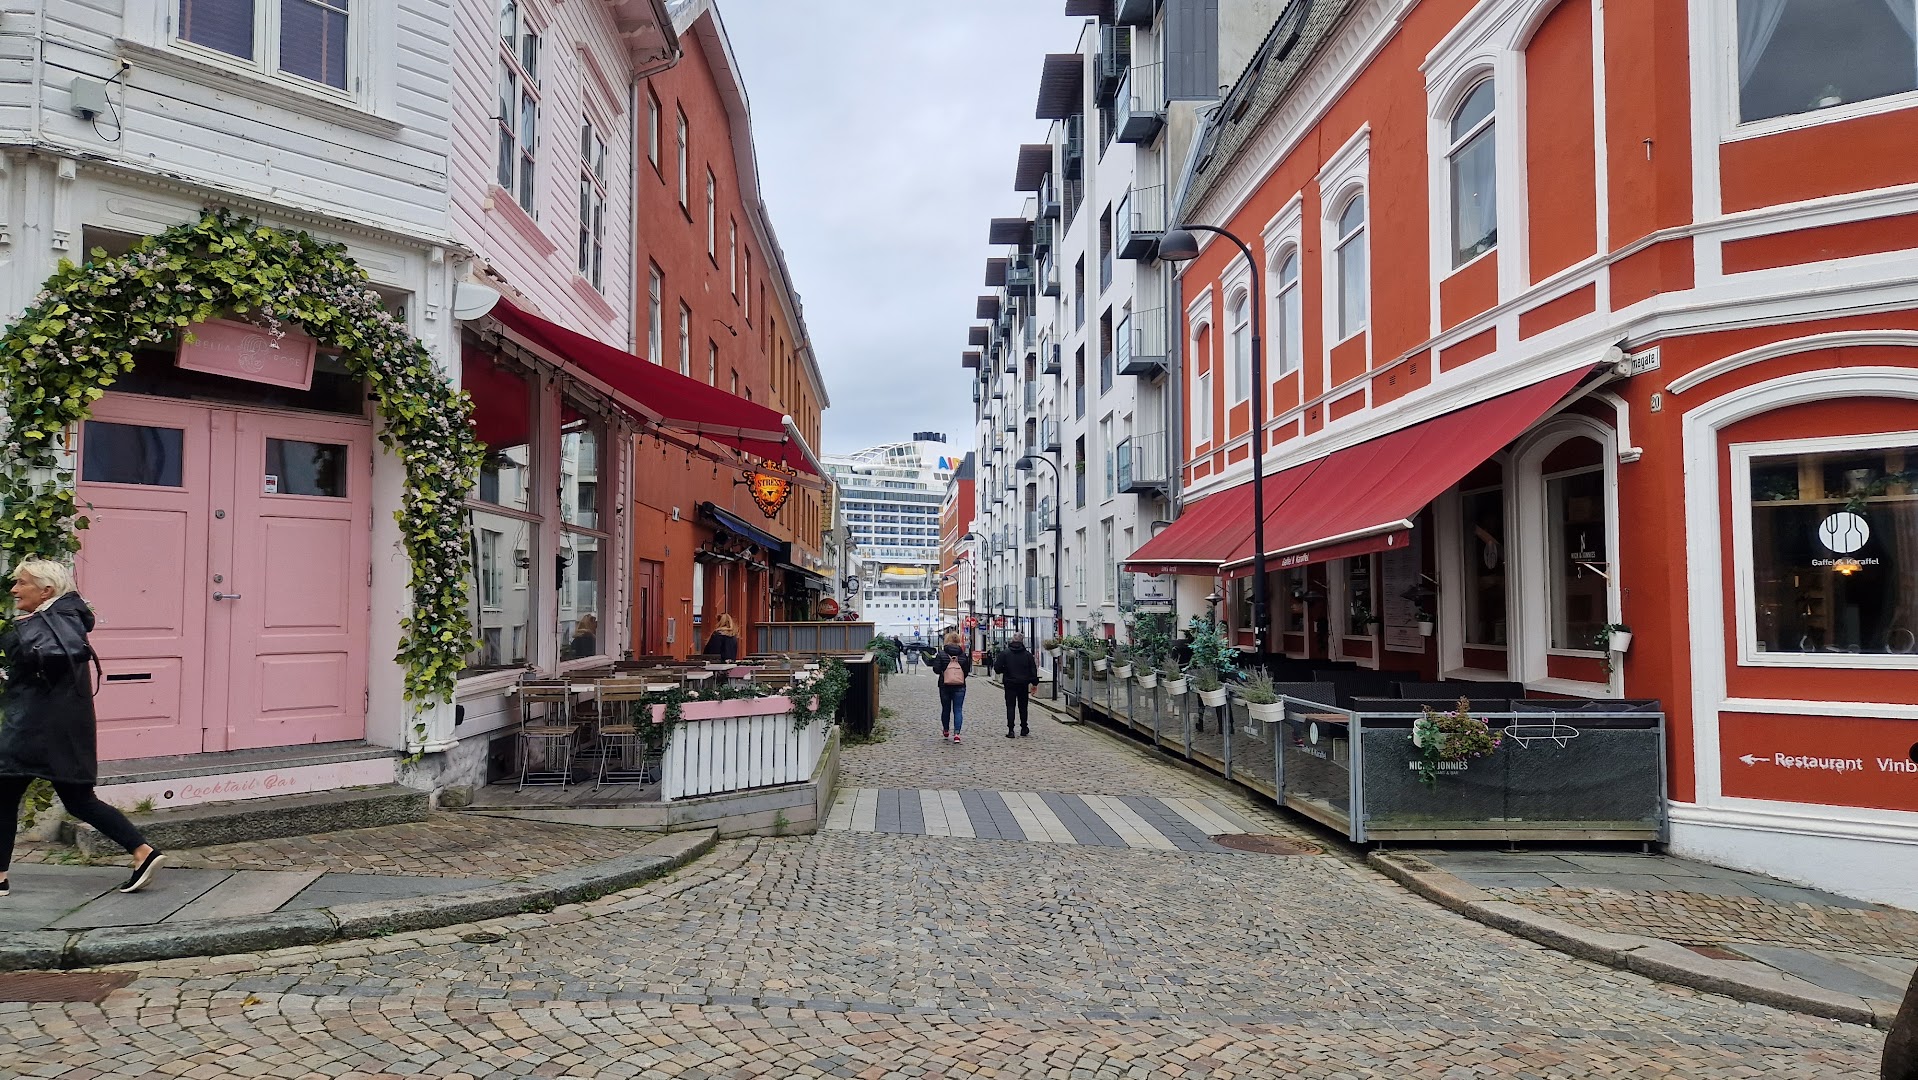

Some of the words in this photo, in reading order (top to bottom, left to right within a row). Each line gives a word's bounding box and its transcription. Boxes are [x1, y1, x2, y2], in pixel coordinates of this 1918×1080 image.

[195, 339, 231, 353] BELLA
[1632, 353, 1655, 369] megate
[1651, 396, 1660, 409] 20
[1846, 558, 1879, 566] Karaffel
[1437, 761, 1469, 770] JONNIES
[1774, 752, 1864, 773] Restaurant
[1876, 757, 1918, 773] Vinb
[180, 778, 256, 799] Cocktail
[264, 774, 297, 790] Bar
